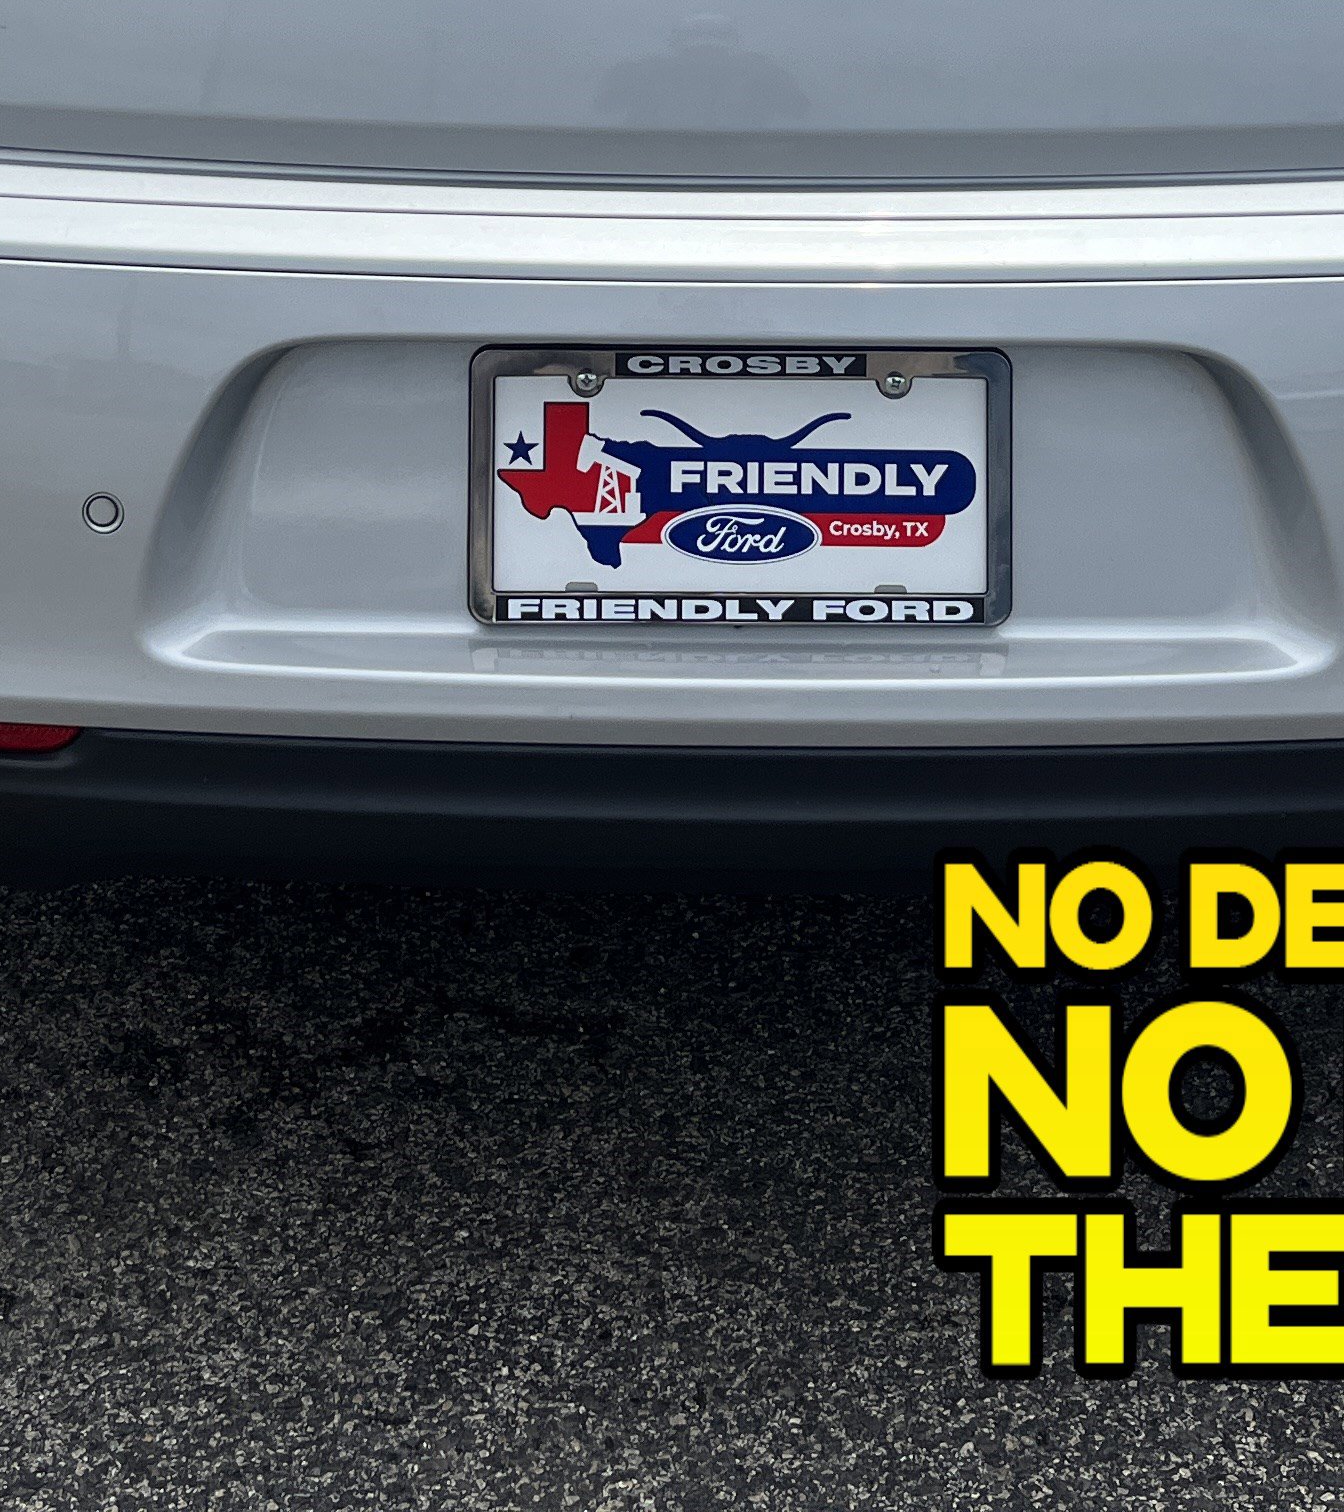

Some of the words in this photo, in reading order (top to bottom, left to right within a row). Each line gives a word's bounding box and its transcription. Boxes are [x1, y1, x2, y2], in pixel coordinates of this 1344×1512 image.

[626, 355, 855, 376] CROSBY
[669, 460, 949, 496] FRIENDLY
[696, 515, 787, 553] Ford
[828, 520, 900, 540] Crosby,
[902, 521, 929, 537] TX
[507, 598, 796, 621] FRIENDLY
[812, 599, 975, 622] FORD
